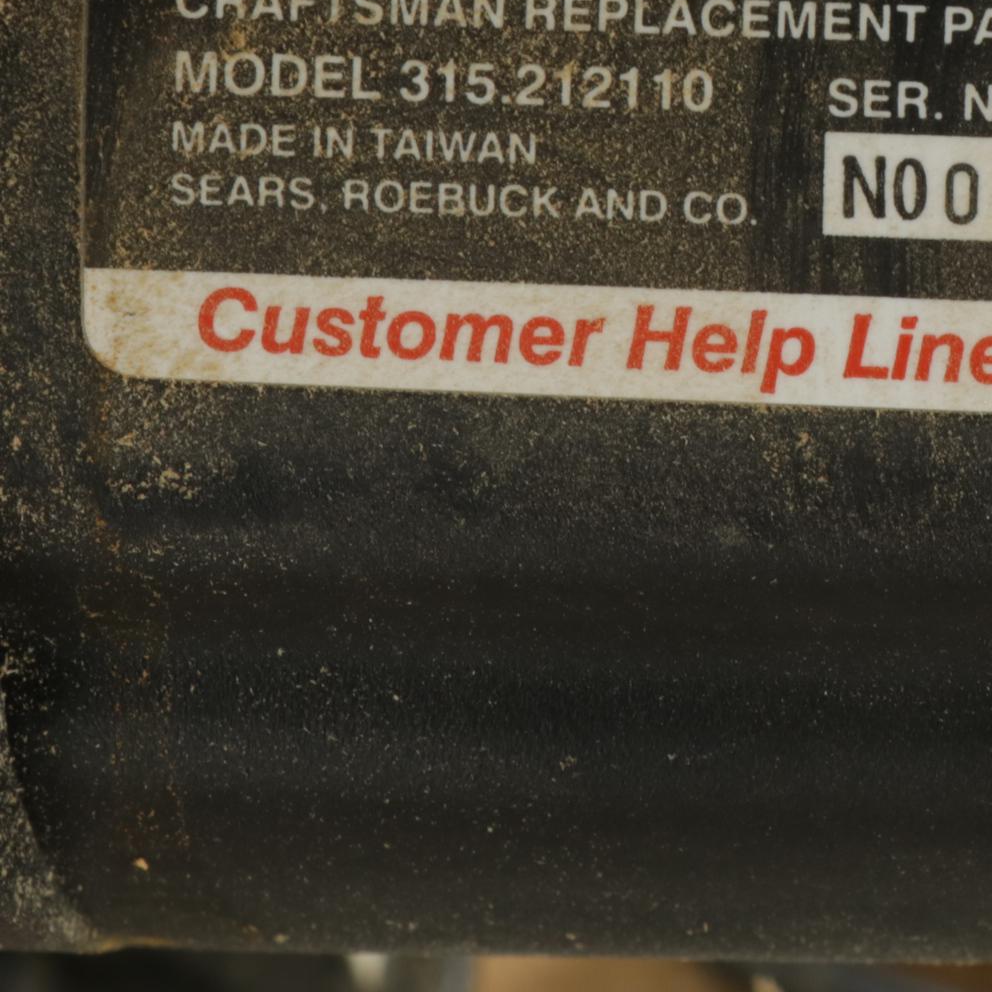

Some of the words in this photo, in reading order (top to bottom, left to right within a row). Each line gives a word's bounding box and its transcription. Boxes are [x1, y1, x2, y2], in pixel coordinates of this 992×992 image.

[174, 50, 382, 101] MODEL
[399, 59, 715, 113] 315.212110
[826, 77, 943, 122] SER.
[171, 120, 297, 158] MADE
[312, 124, 355, 160] IN
[371, 128, 537, 165] TAIWAN
[169, 173, 330, 215] SEARS,
[342, 178, 562, 219] ROEBUCK
[574, 188, 669, 225] AND
[682, 191, 759, 227] CO.
[198, 285, 606, 368] Customer
[625, 304, 817, 396] Help
